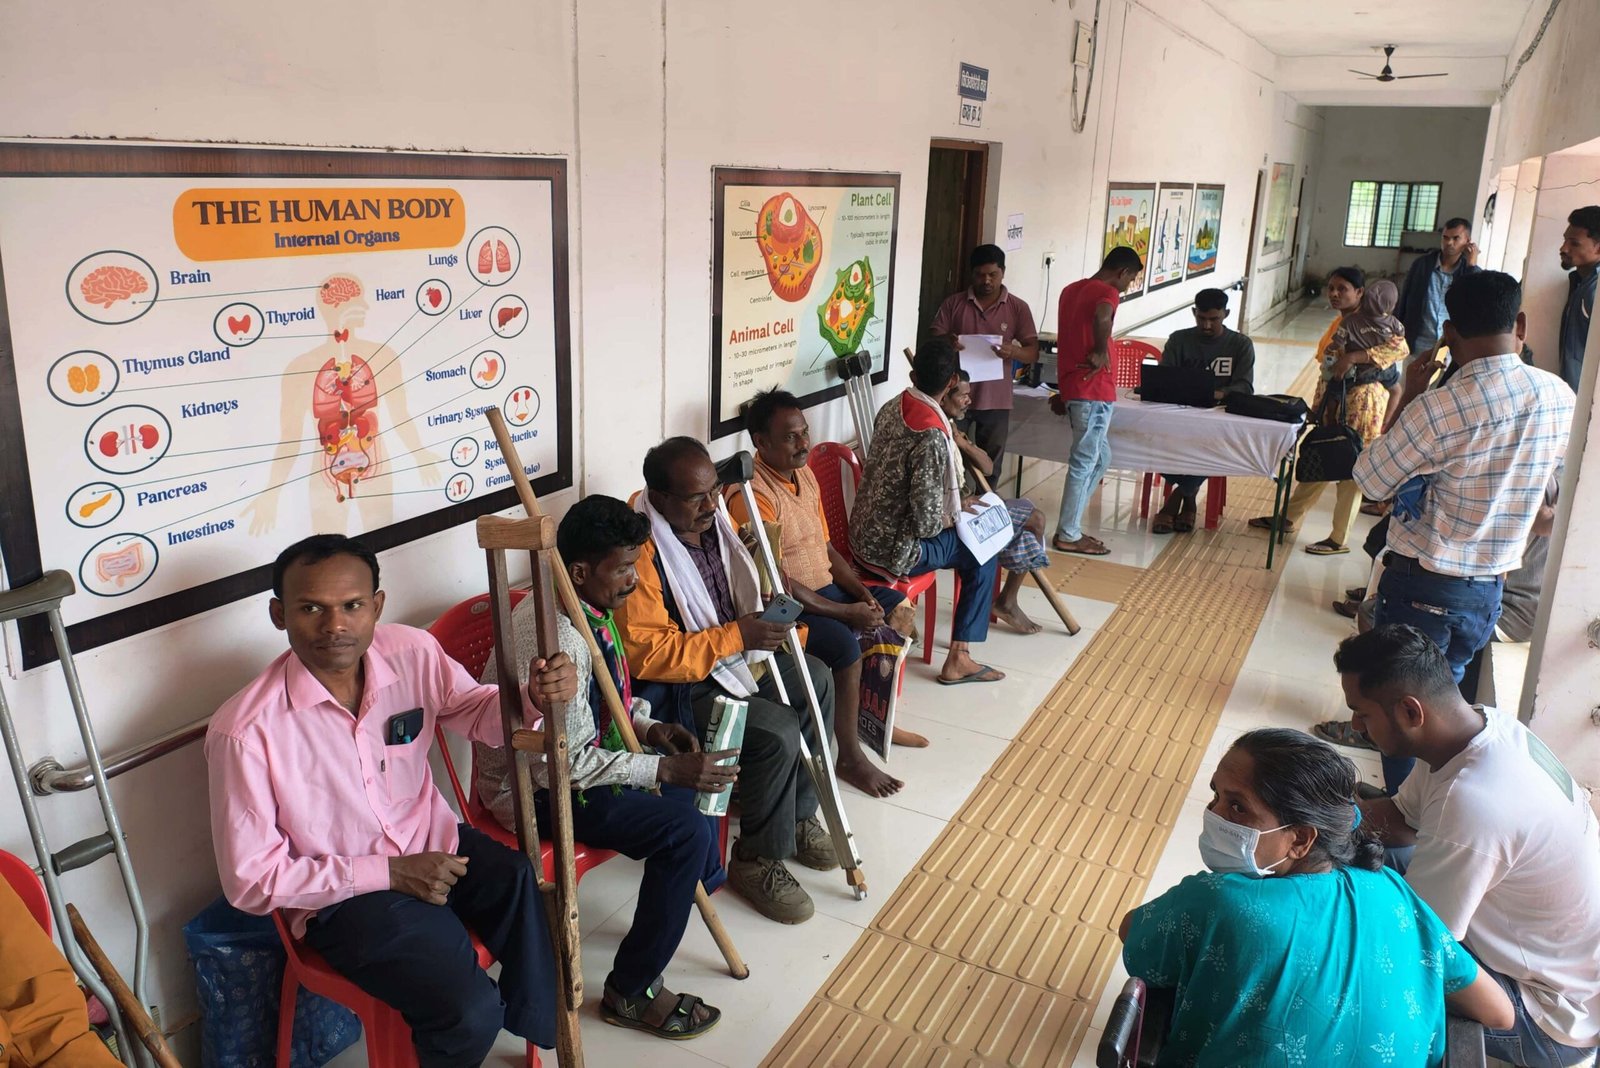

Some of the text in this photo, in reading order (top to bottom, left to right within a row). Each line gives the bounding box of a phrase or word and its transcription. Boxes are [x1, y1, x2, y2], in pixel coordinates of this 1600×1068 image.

[851, 192, 891, 206] Plant Cell
[192, 197, 455, 226] THE HUMAN BODY
[274, 227, 400, 249] Internal Organs
[428, 252, 458, 269] Lungs
[170, 269, 211, 285] Brain
[742, 268, 765, 276] membrane
[376, 287, 405, 302] Heart
[266, 307, 315, 325] Thyroid
[459, 307, 482, 321] Liver
[729, 318, 794, 345] Animal Cell
[748, 344, 778, 356] micrometers
[123, 347, 231, 375] Thymus Gland
[426, 365, 466, 382] Stomach
[734, 367, 754, 379] Typically
[181, 399, 238, 418] Kidneys
[427, 410, 464, 428] Urinary
[137, 481, 208, 506] Pancreas
[168, 519, 235, 545] Intestines
